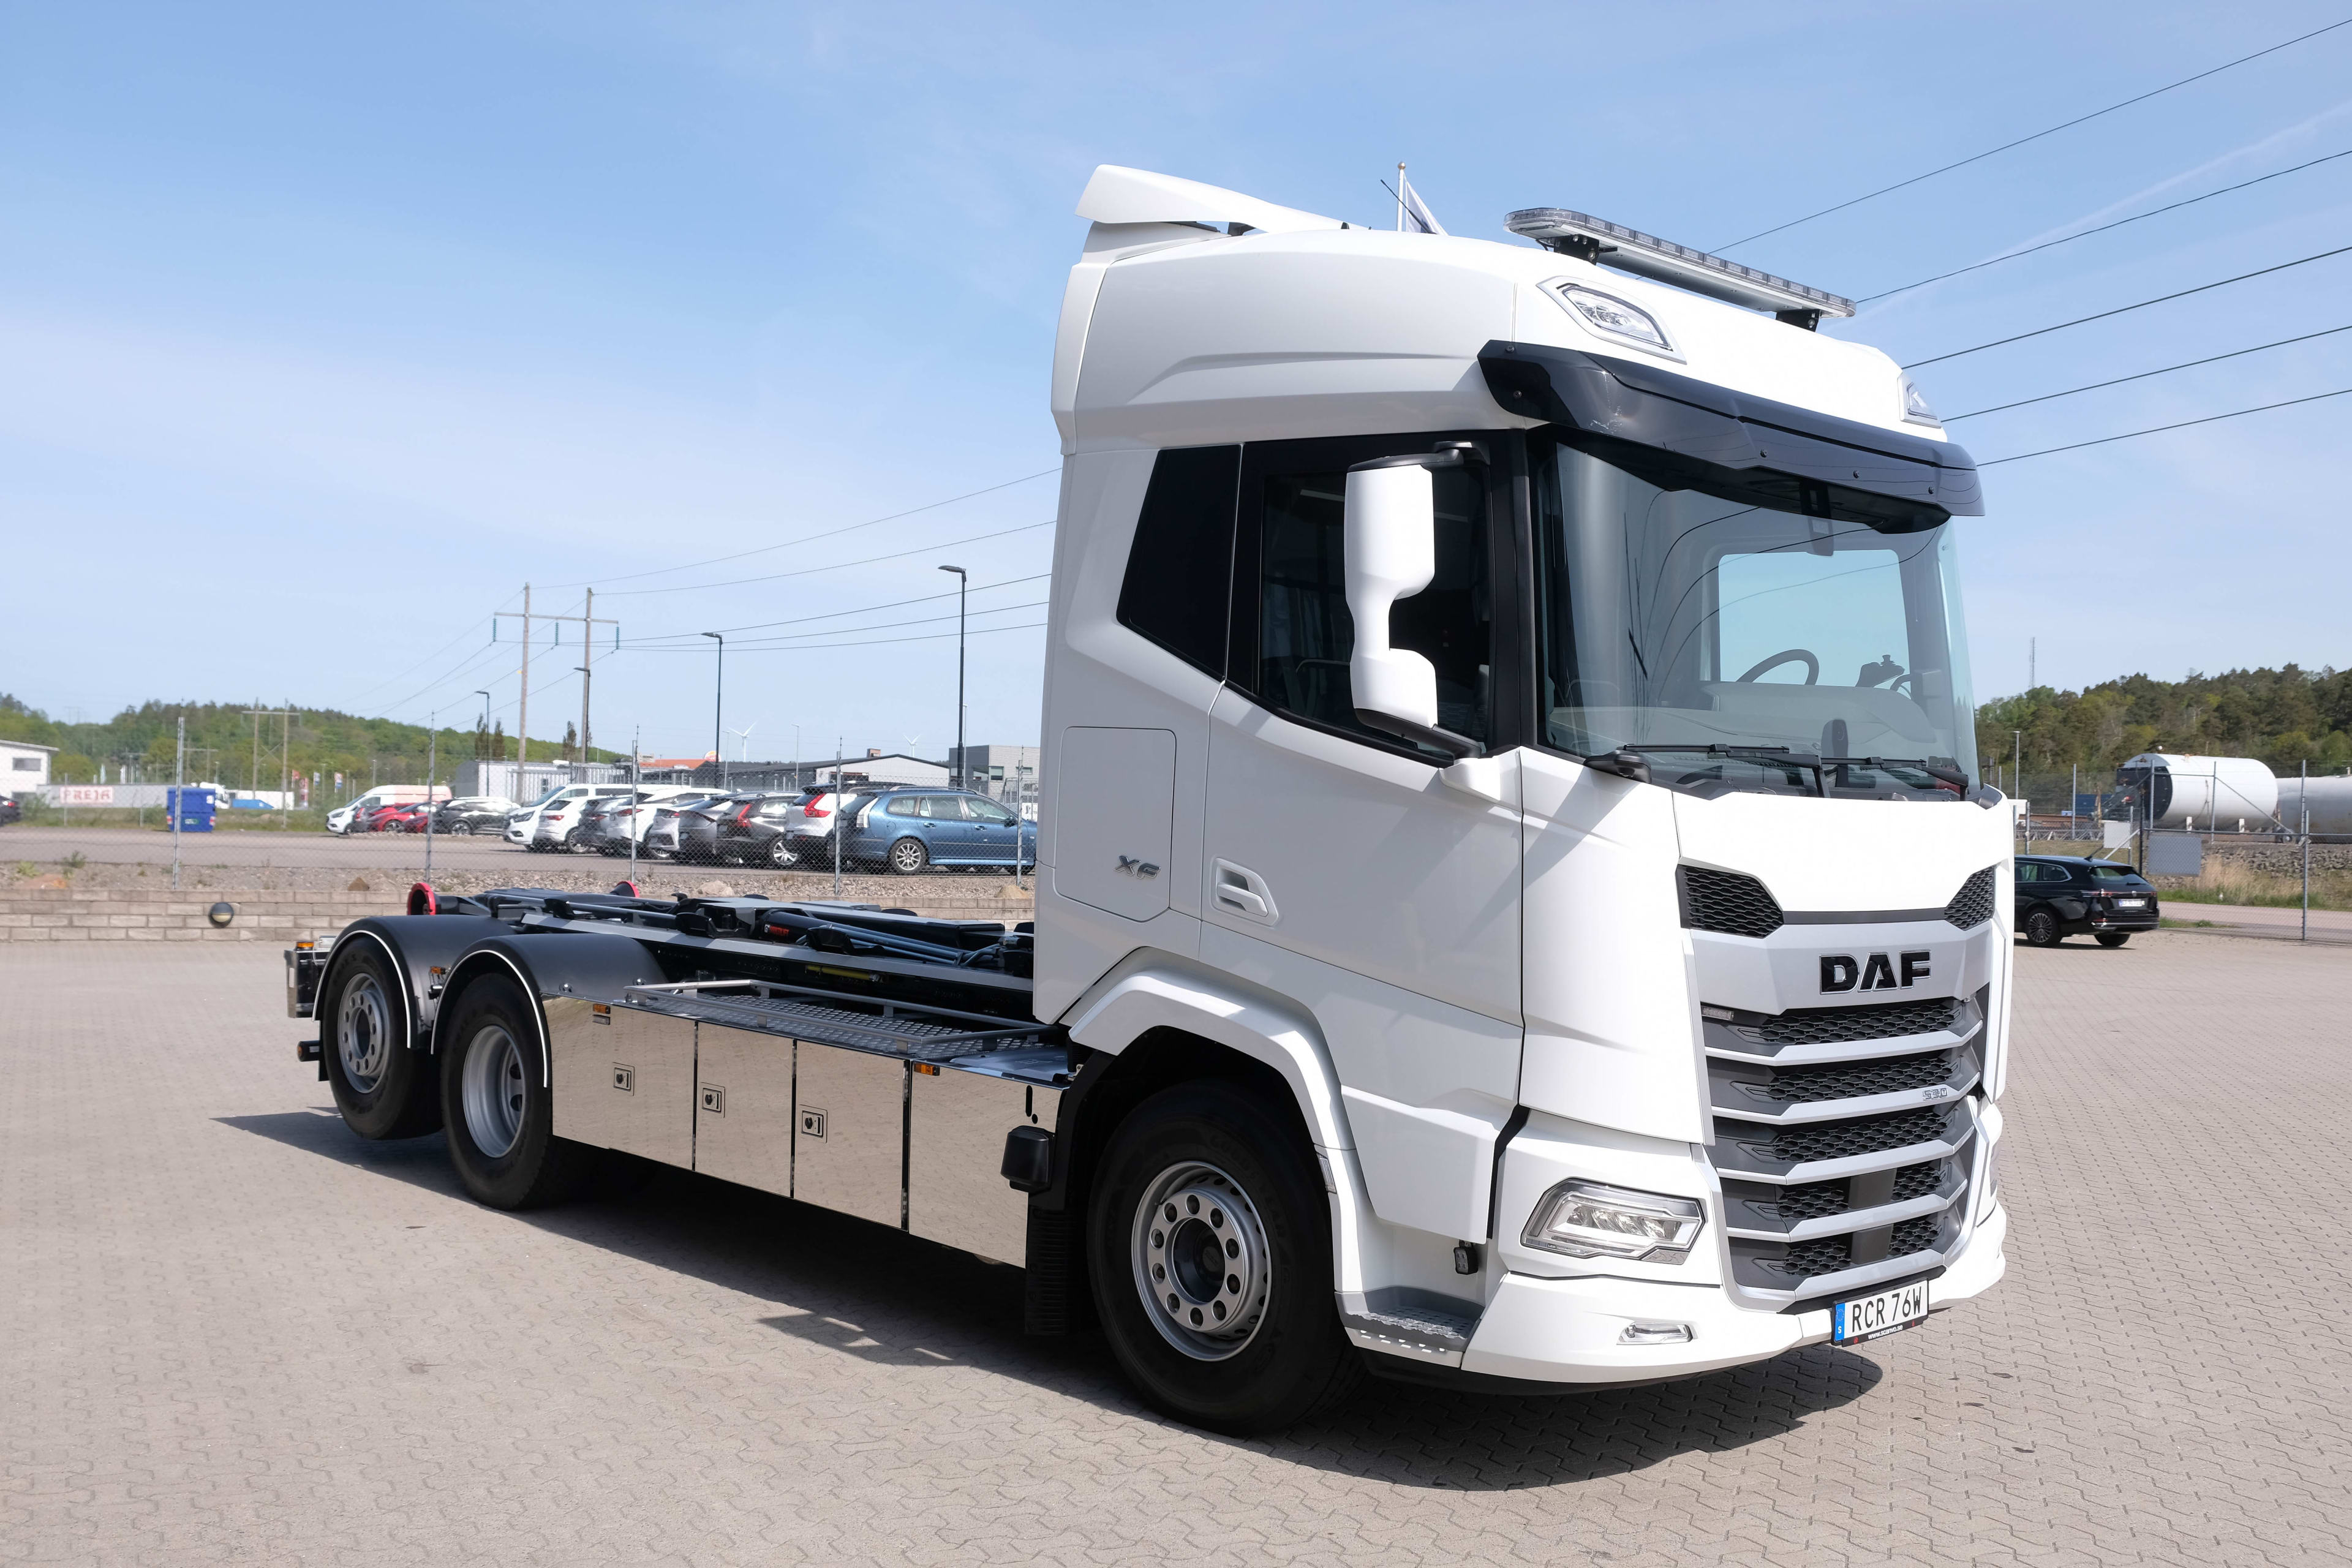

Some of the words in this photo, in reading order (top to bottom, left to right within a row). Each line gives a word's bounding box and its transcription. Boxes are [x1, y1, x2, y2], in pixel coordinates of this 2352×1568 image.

[1114, 855, 1161, 880] XF
[1819, 950, 1931, 995] DAF
[1923, 1087, 1948, 1101] 530
[1852, 1297, 1885, 1333] RCR
[1891, 1286, 1922, 1322] 76W
[1838, 1325, 1842, 1334] S
